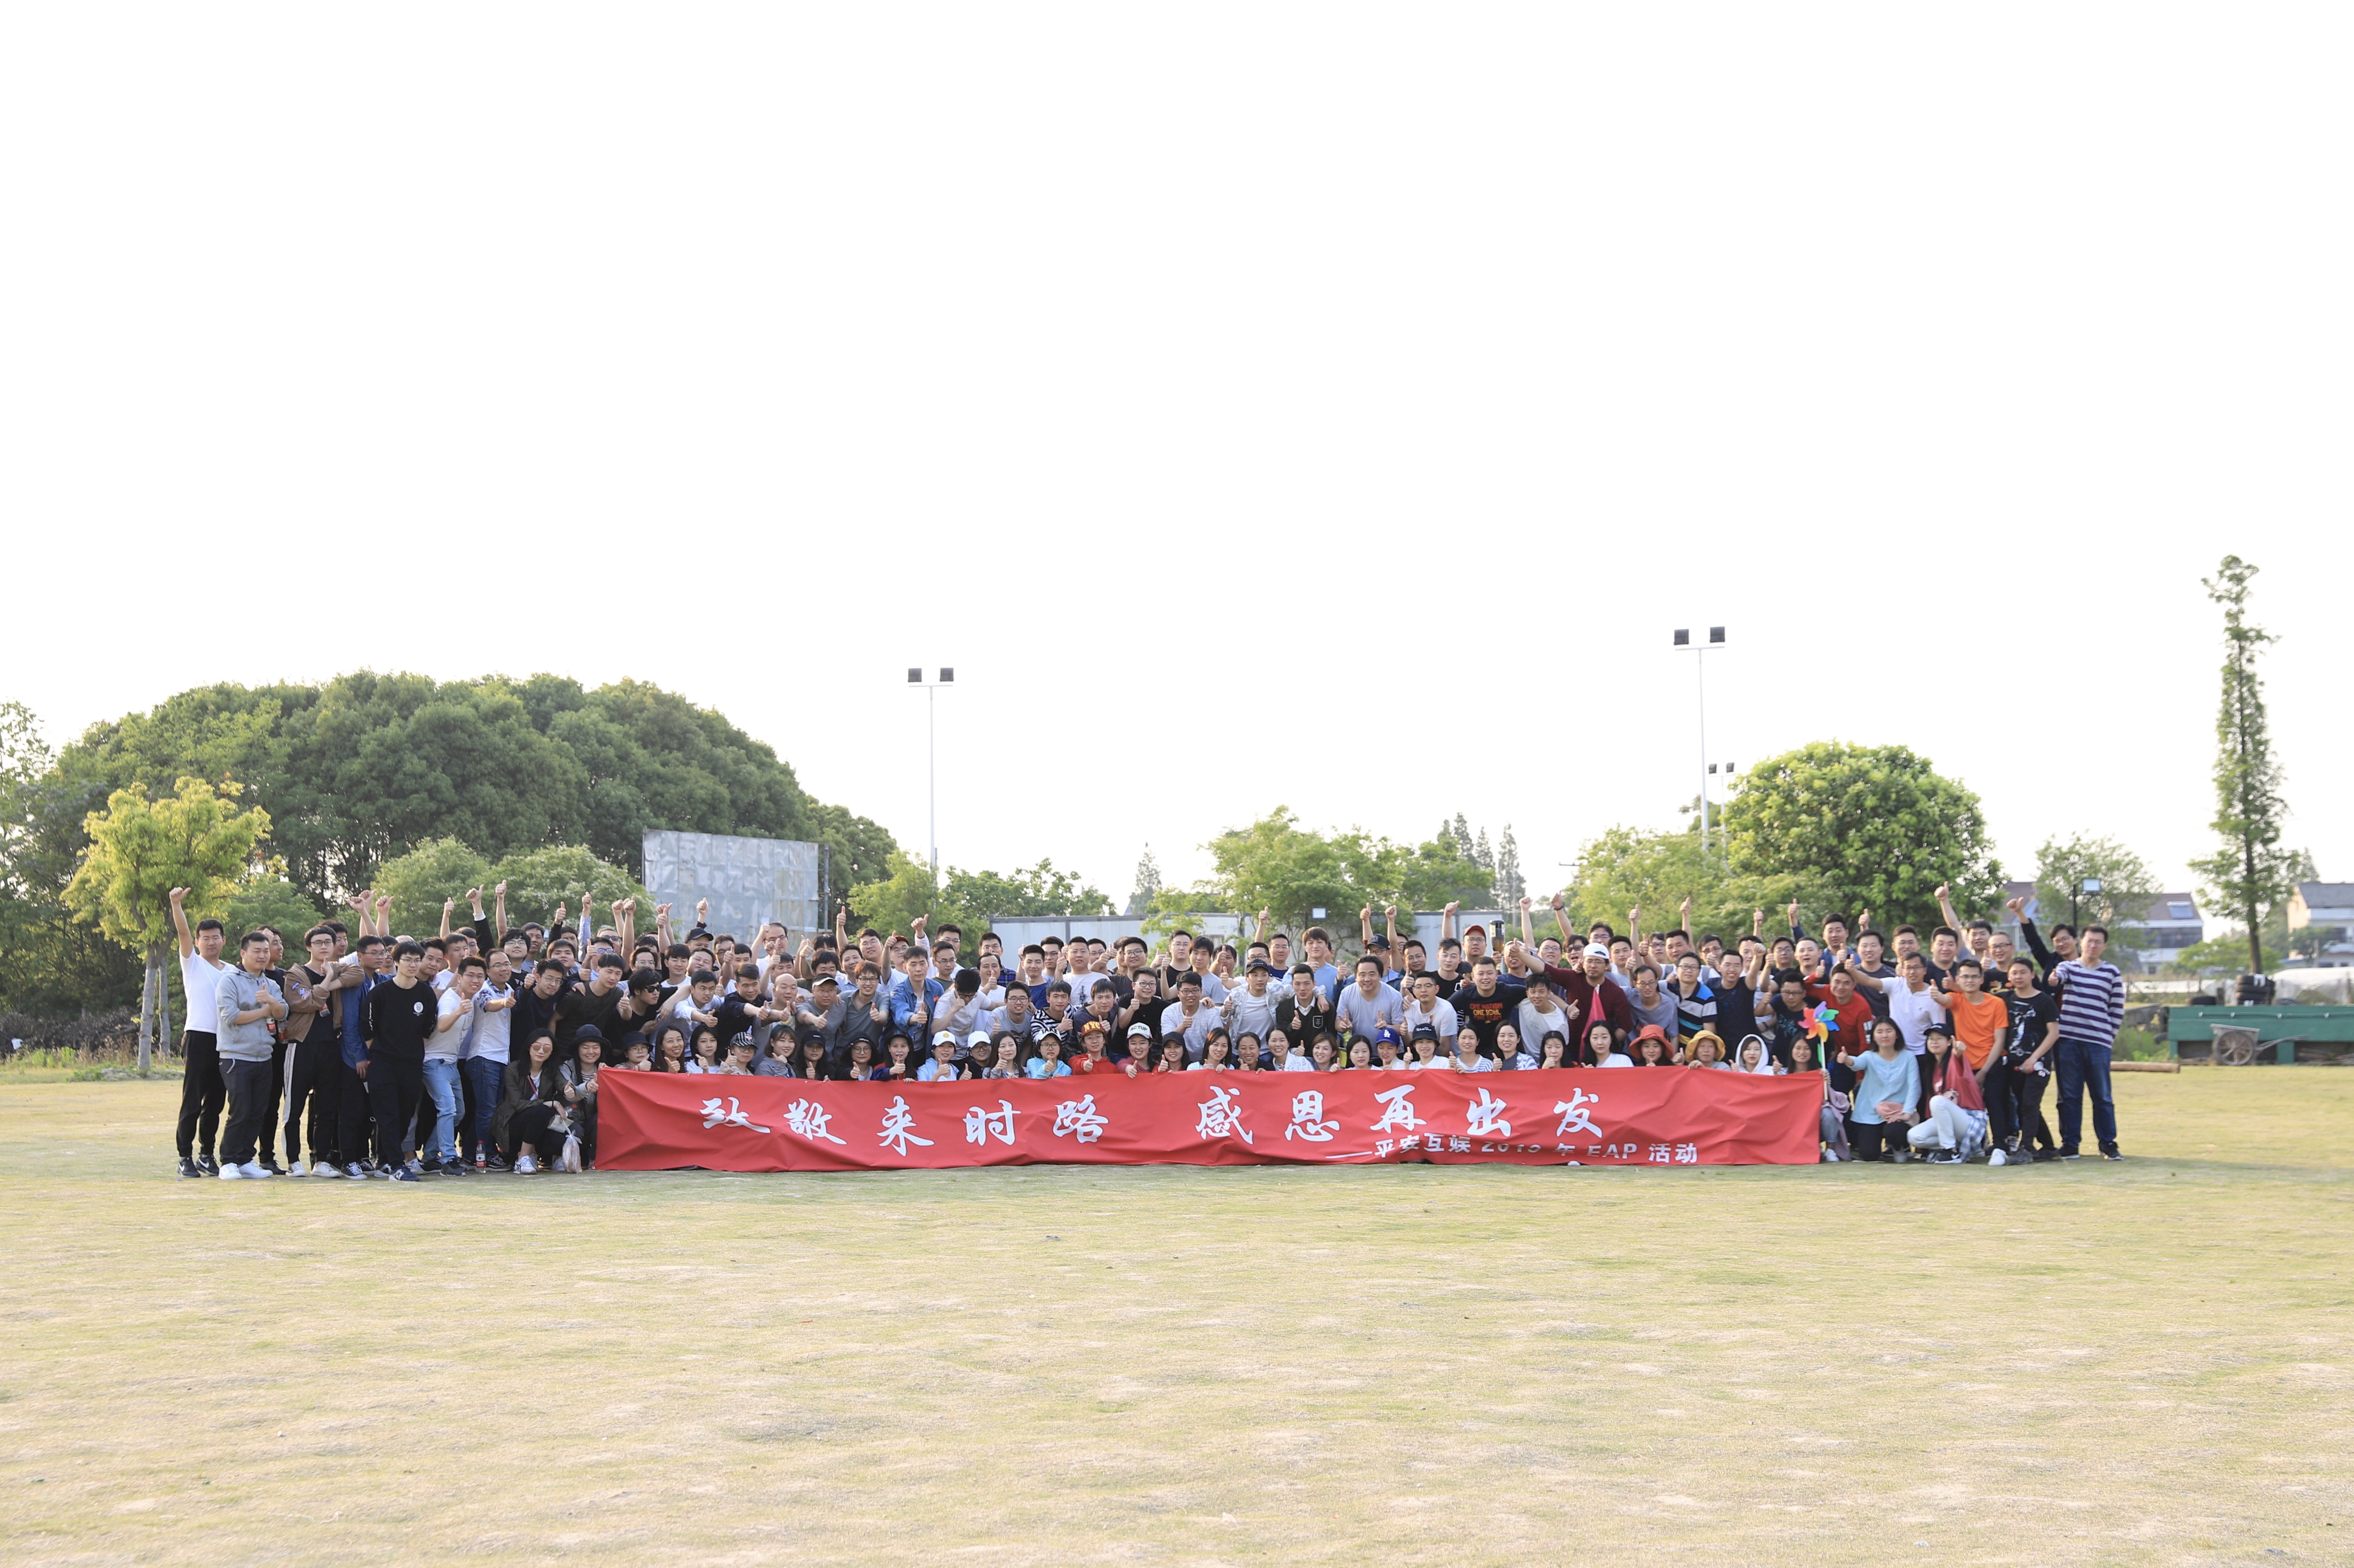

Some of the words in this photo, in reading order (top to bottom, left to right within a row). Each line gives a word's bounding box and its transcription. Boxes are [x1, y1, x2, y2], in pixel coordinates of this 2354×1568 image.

[1083, 1021, 1100, 1032] NYC
[698, 1094, 1109, 1157] 致敬来时路
[1195, 1084, 1603, 1145] 感恩再出发
[1586, 1143, 1638, 1159] EAP
[1648, 1142, 1698, 1164] 活动
